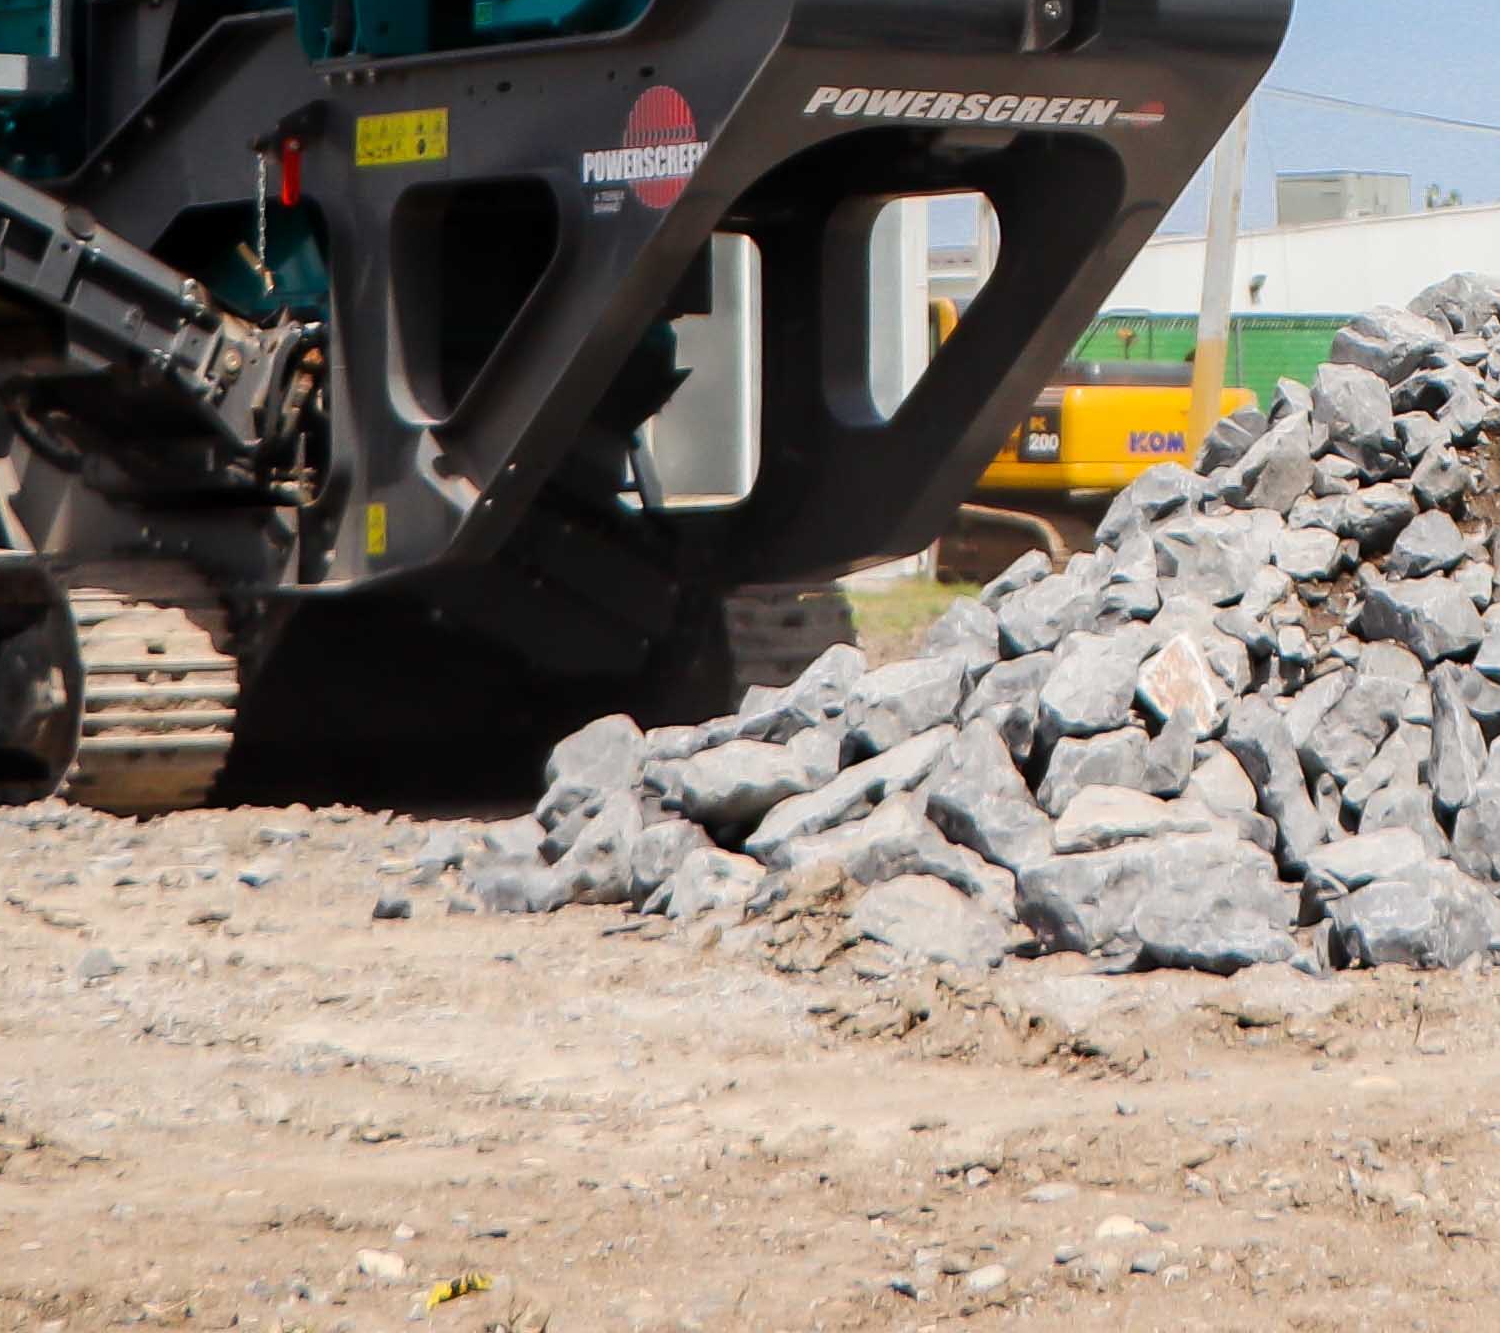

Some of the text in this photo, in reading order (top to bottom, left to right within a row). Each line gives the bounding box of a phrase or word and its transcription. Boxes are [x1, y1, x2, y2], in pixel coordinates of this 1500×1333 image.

[804, 86, 1120, 125] POWERSCREEN
[583, 141, 708, 183] POWERSCREE
[1028, 433, 1059, 452] 200
